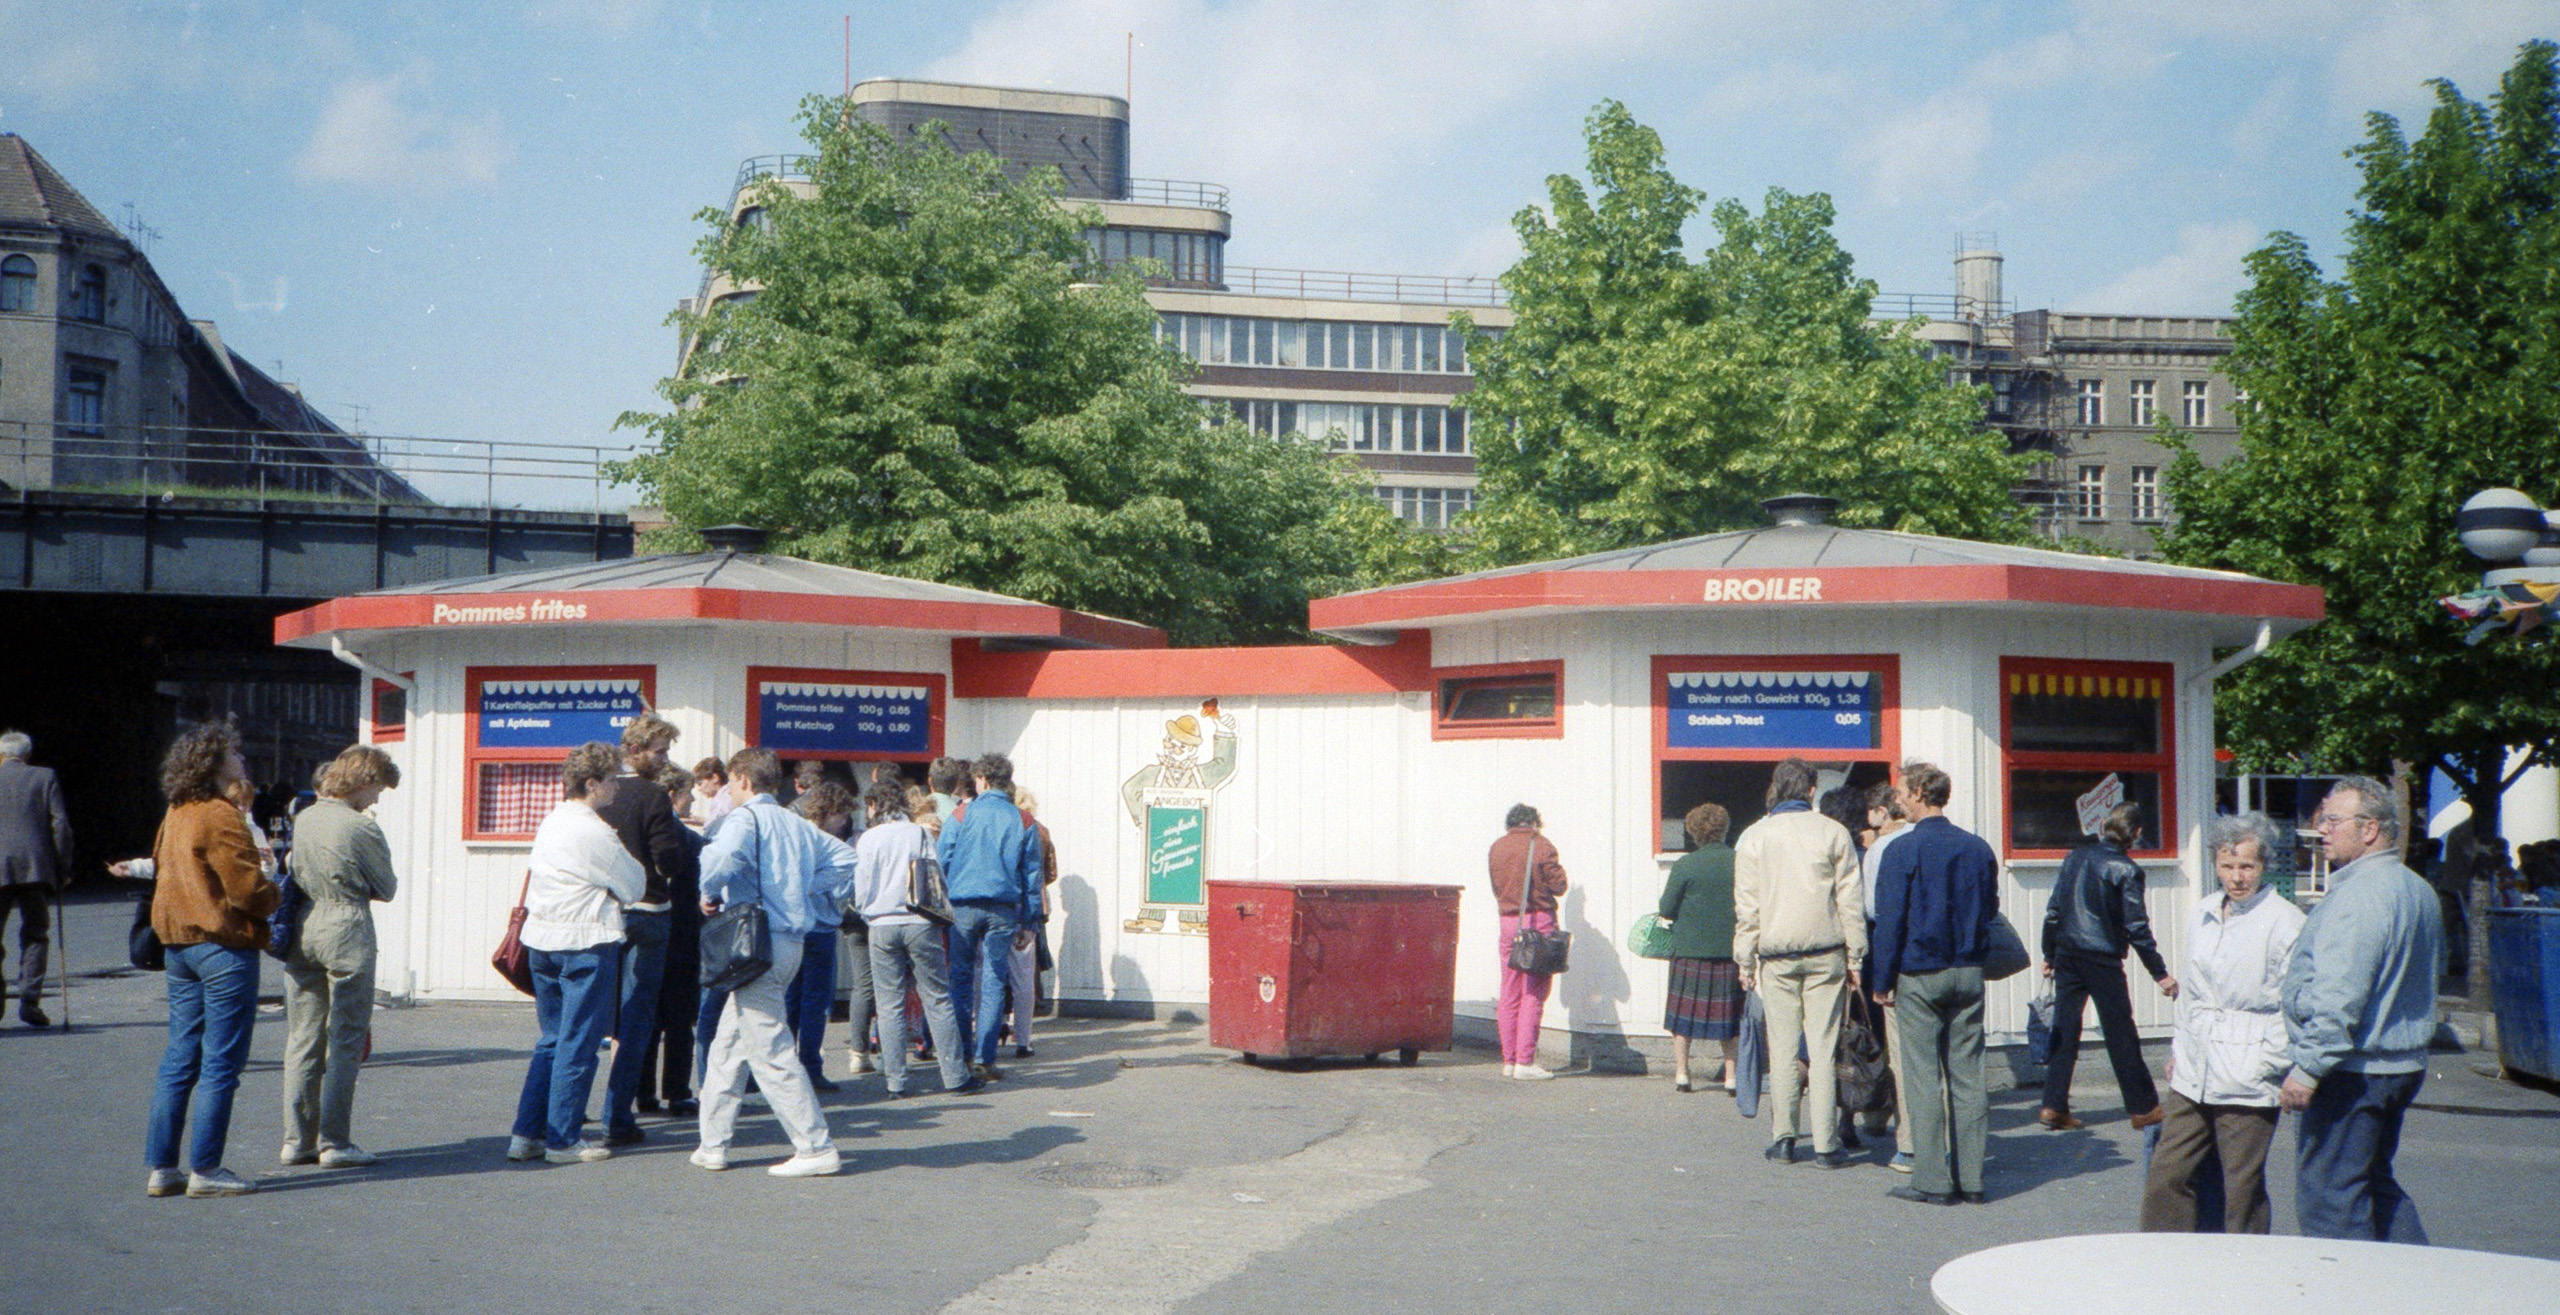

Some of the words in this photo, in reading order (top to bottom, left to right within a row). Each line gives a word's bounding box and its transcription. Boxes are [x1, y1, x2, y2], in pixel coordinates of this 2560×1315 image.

[1703, 577, 1822, 602] BROILER
[433, 603, 526, 624] Pommes
[530, 599, 588, 621] frites
[1687, 693, 1722, 704] Broiler
[1725, 693, 1751, 704] nach
[1755, 693, 1799, 705] Gewicht
[490, 701, 557, 712] Kartoffelpuffer
[558, 700, 573, 709] mit
[576, 699, 609, 710] Zucker
[776, 702, 818, 713] Pommes
[819, 703, 845, 714] frites
[489, 718, 505, 728] mit
[506, 718, 550, 730] Apfelmus
[775, 720, 792, 730] mit
[794, 720, 835, 732] Ketchup
[1687, 714, 1732, 726] Scheibe
[1732, 714, 1765, 726] Toast
[1153, 796, 1205, 809] ANGEBOT
